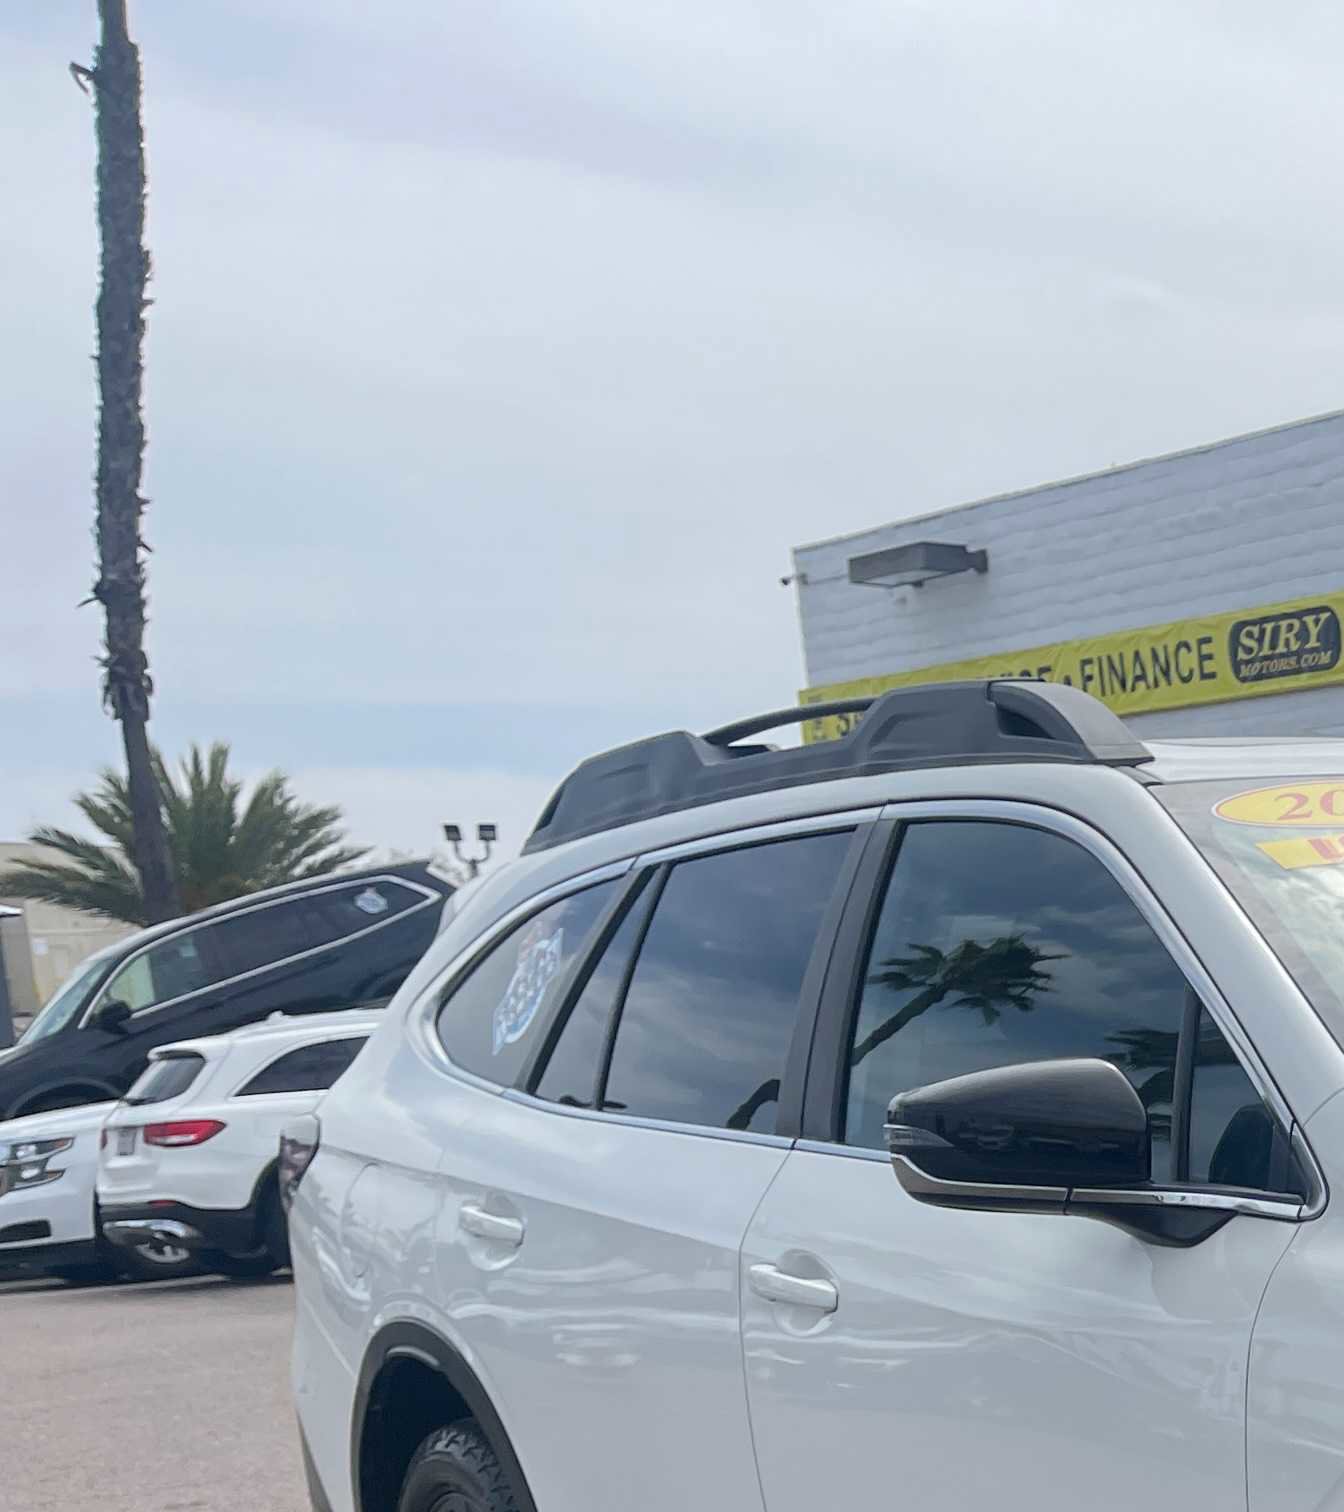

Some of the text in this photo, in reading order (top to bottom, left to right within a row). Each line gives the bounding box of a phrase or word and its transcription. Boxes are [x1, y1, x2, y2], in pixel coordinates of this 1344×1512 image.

[1236, 611, 1333, 662] SIRY
[1079, 636, 1217, 697] FINANCE
[1240, 650, 1333, 678] MOTORS.COM
